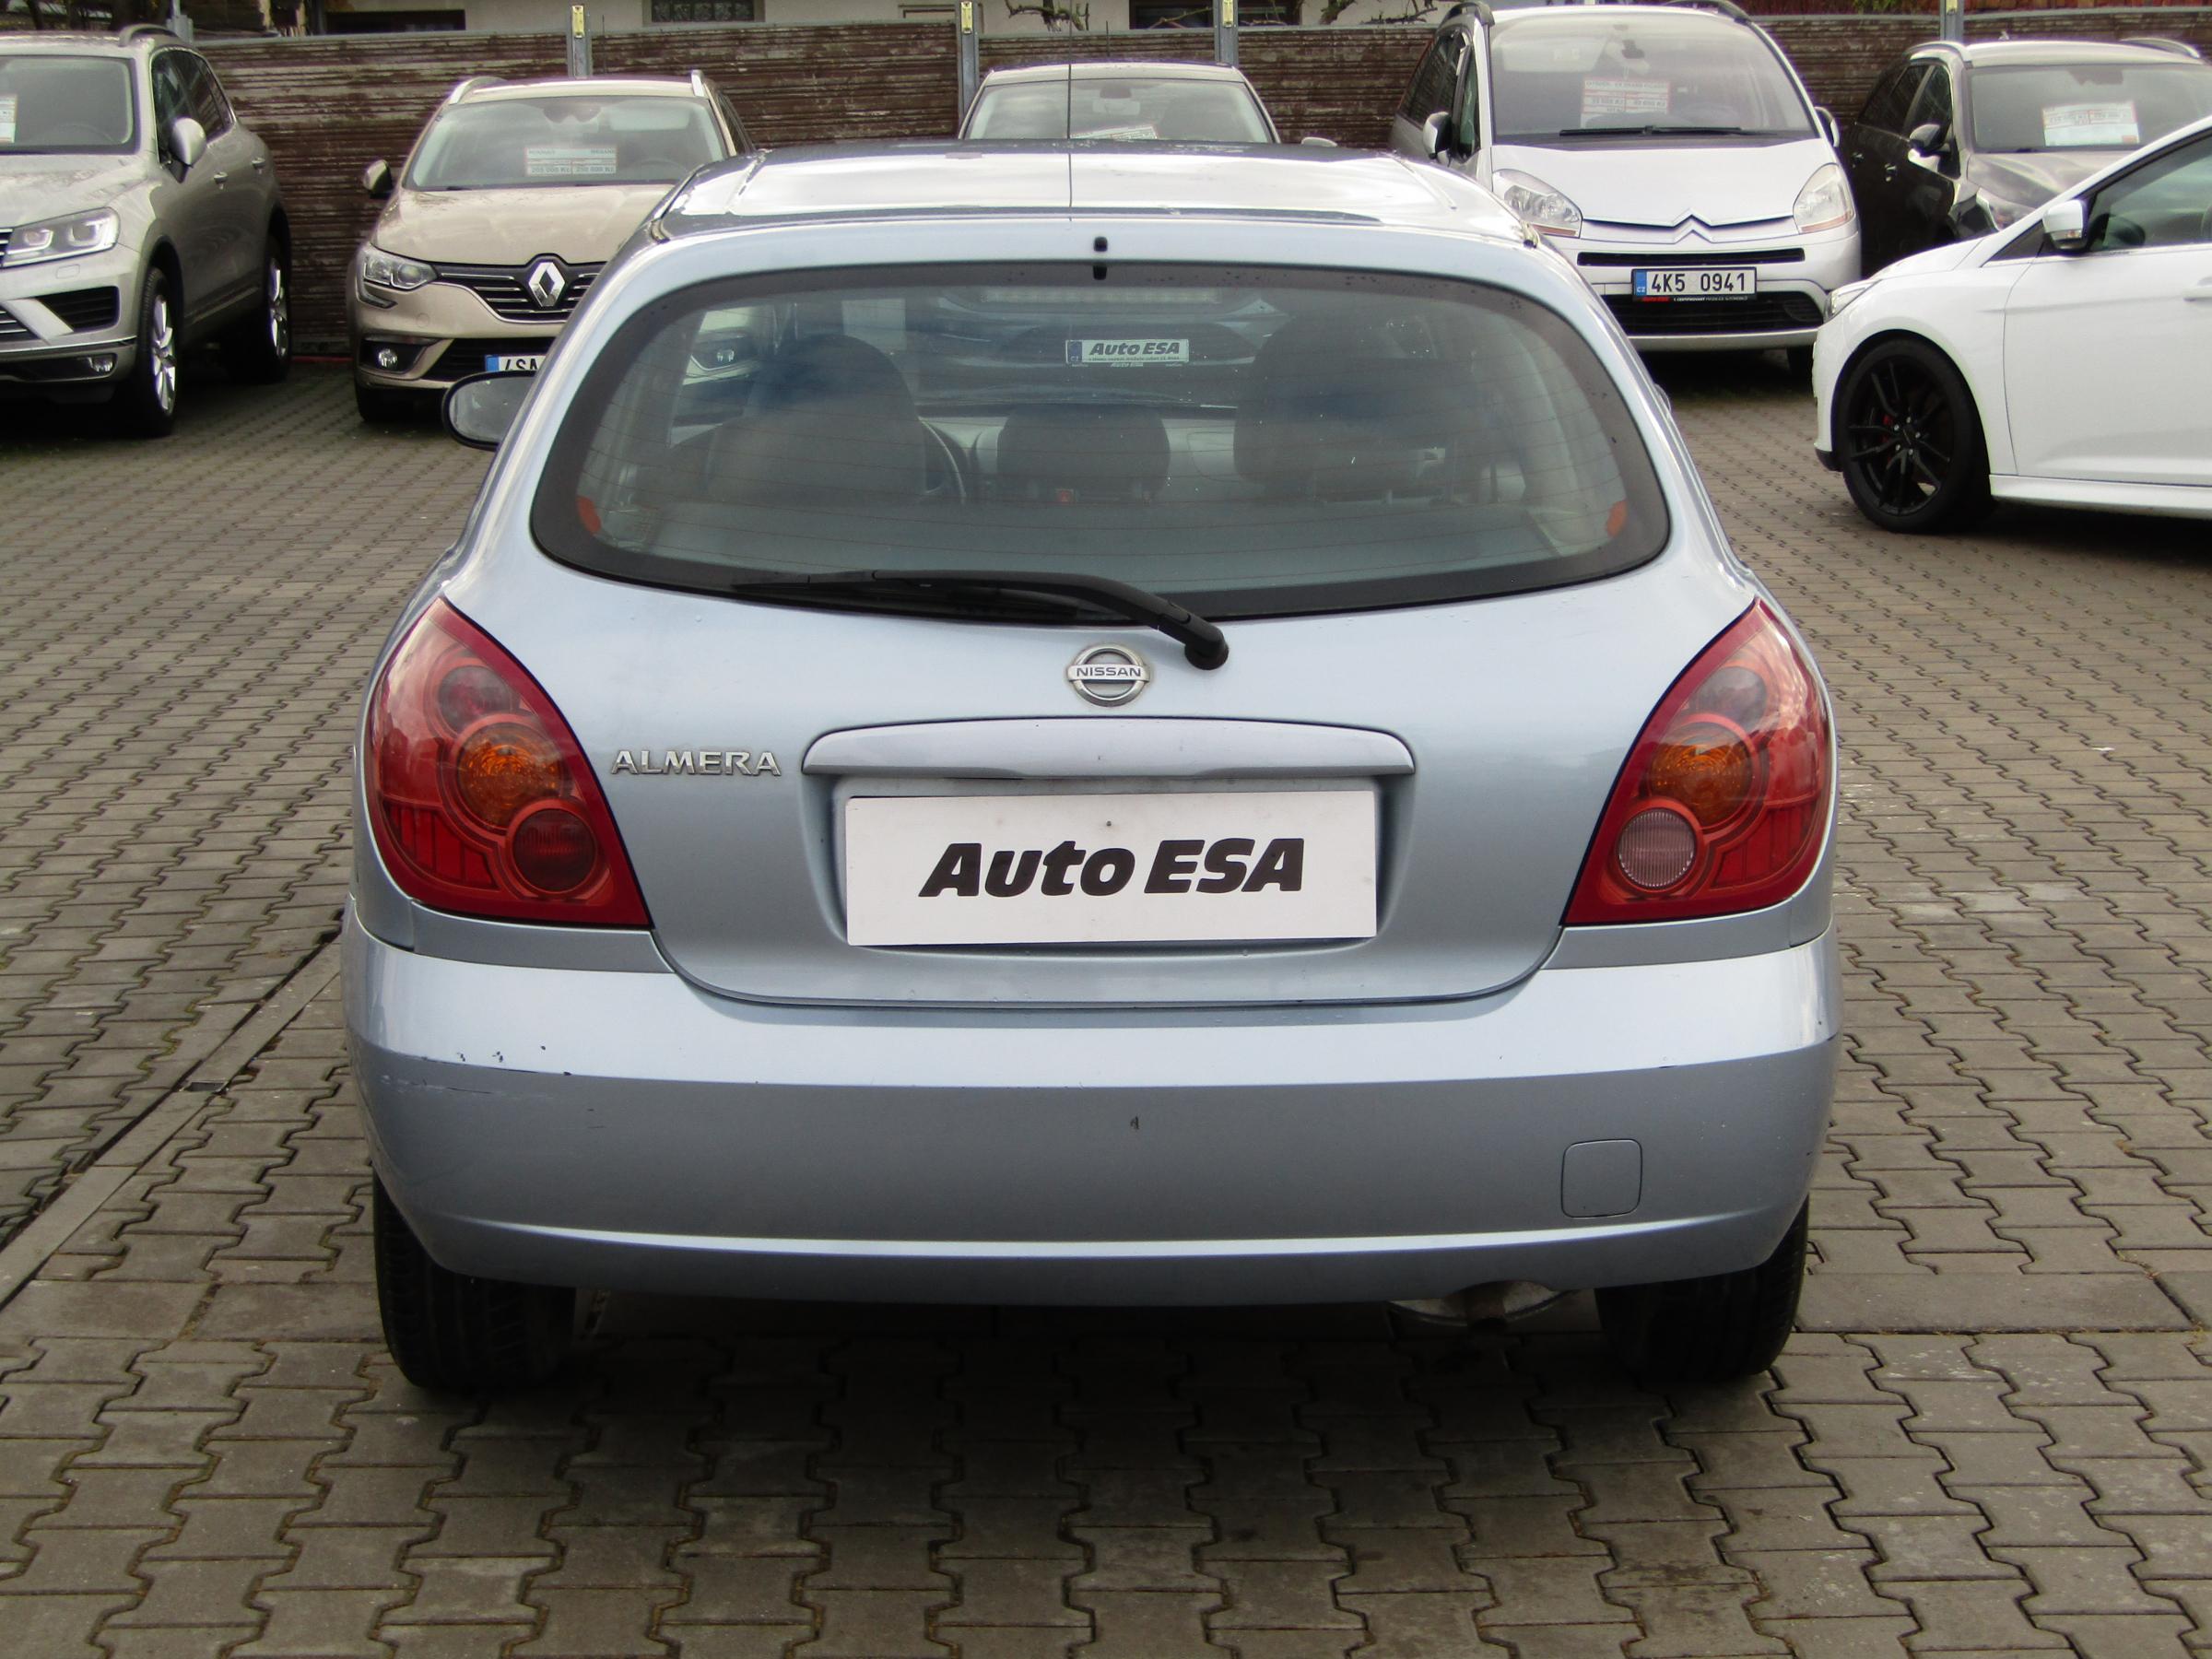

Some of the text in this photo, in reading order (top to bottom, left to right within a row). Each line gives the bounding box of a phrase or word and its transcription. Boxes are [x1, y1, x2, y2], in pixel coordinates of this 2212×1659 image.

[1651, 273, 1746, 292] 4K5 0941
[1089, 342, 1180, 355] Auto ESA
[1077, 666, 1141, 677] NISSAN
[610, 750, 782, 776] ALMERA
[918, 838, 1305, 898] Auto ESA
